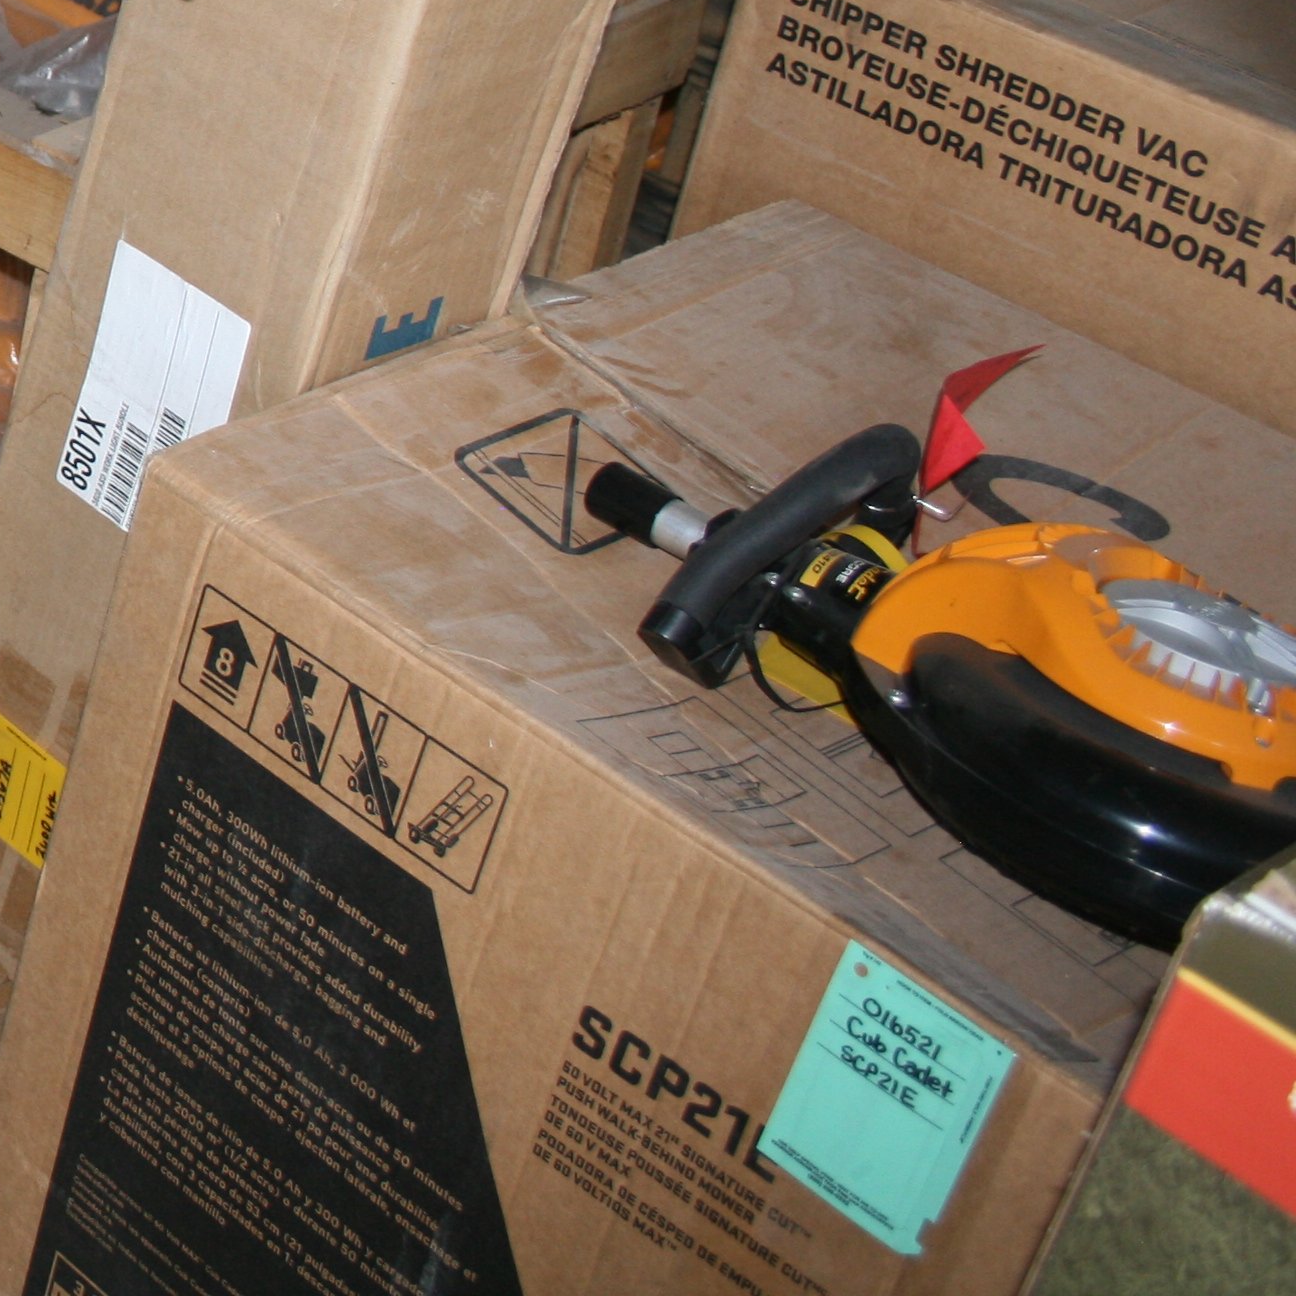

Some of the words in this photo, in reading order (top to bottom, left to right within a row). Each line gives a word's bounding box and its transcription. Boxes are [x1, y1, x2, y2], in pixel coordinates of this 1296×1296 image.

[764, 51, 984, 170] ASTILLADORA
[998, 152, 1246, 288] TRITURADORA
[776, 14, 1266, 248] BROYEUSE-DÉCHIQUETEUSE
[934, 43, 1125, 145] SHREDDER
[1137, 126, 1208, 178] VAC
[60, 406, 107, 491] 8501X
[160, 881, 209, 927] mulching
[173, 833, 212, 870] charge,
[217, 866, 259, 904] without
[260, 902, 297, 934] power
[300, 930, 325, 956] fade
[176, 812, 202, 838] Mow
[205, 837, 219, 853] up
[222, 849, 233, 864] to
[250, 873, 278, 901] acre,
[282, 898, 296, 911] or
[298, 907, 314, 926] 50
[317, 925, 364, 966] minutes
[368, 965, 383, 981] on
[398, 987, 434, 1019] single
[182, 799, 223, 834] charger
[227, 832, 284, 882] (included)
[185, 778, 221, 816] 5.0Ah,
[226, 810, 267, 850] 300Wh
[270, 844, 333, 900] lithium-ion
[336, 895, 380, 936] battery
[382, 933, 407, 954] and
[146, 928, 194, 970] chargeur
[196, 967, 249, 1016] (compris)
[150, 910, 192, 951] Batterie
[195, 950, 209, 965] au
[211, 959, 271, 1016] lithium-ion
[274, 1014, 289, 1030] de
[380, 1095, 399, 1119] Wh
[402, 1118, 415, 1131] et
[164, 863, 187, 888] with
[190, 883, 223, 916] 3-in-1
[226, 914, 310, 989] side-discharge,
[314, 983, 360, 1028] bagging
[363, 1024, 386, 1046] and
[167, 845, 194, 874] 21-in
[197, 872, 211, 886] all
[214, 885, 241, 911] steel
[243, 907, 269, 934] deck
[271, 932, 321, 975] provides
[324, 973, 360, 1005] added
[362, 1002, 420, 1052] durability
[130, 991, 165, 1024] accrue
[168, 1023, 179, 1036] et
[191, 1043, 231, 1080] options
[234, 1078, 247, 1094] de
[250, 1093, 284, 1124] coupe
[394, 1213, 458, 1269] ensachage
[463, 1269, 475, 1280] et
[134, 972, 173, 1012] Plateau
[176, 1010, 189, 1026] de
[191, 1024, 223, 1055] coupe
[226, 1053, 240, 1069] en
[242, 1067, 271, 1093] acier
[274, 1092, 288, 1108] de
[290, 1104, 304, 1122] 21
[306, 1120, 322, 1136] po
[324, 1135, 352, 1160] pour
[355, 1160, 377, 1182] une
[138, 960, 155, 977] sur
[158, 976, 178, 997] une
[180, 995, 209, 1023] seule
[211, 1022, 249, 1056] charge
[251, 1055, 277, 1080] sans
[279, 1079, 311, 1108] perte
[313, 1106, 328, 1122] de
[330, 1121, 389, 1172] puissance
[142, 943, 199, 995] Autonomie
[201, 993, 215, 1009] de
[218, 1005, 246, 1034] tonte
[249, 1033, 268, 1051] sur
[270, 1050, 292, 1072] une
[294, 1070, 353, 1122] demi-acre
[356, 1121, 371, 1137] ou
[374, 1136, 389, 1152] de
[392, 1148, 410, 1167] 50
[412, 1167, 461, 1210] minutes
[562, 1060, 579, 1079] 60
[583, 1074, 617, 1103] VOLT
[619, 1101, 652, 1130] MAX
[681, 1144, 765, 1212] SIGNATURE
[841, 1045, 919, 1109] SCP21E
[846, 1016, 887, 1053] Cub
[892, 1047, 954, 1098] Cadet
[532, 1142, 551, 1163] DE
[553, 1158, 571, 1177] 60
[574, 1172, 630, 1221] VOLTIOS
[538, 1129, 612, 1190] PODADORA
[618, 1186, 636, 1206] DE
[638, 1202, 694, 1249] CÉSPED
[696, 1244, 718, 1266] DE
[718, 1261, 766, 1296] EMPU
[544, 1110, 563, 1130] DE
[565, 1125, 583, 1144] 60
[586, 1138, 596, 1151] V
[596, 1147, 631, 1178] MAX
[550, 1094, 626, 1160] TONDEUSE
[626, 1148, 692, 1204] POUSSÉE
[694, 1196, 780, 1268] SIGNATURE
[556, 1076, 594, 1108] PUSH
[598, 1104, 695, 1180] WALK-BEHIND
[697, 1176, 754, 1225] MOWER
